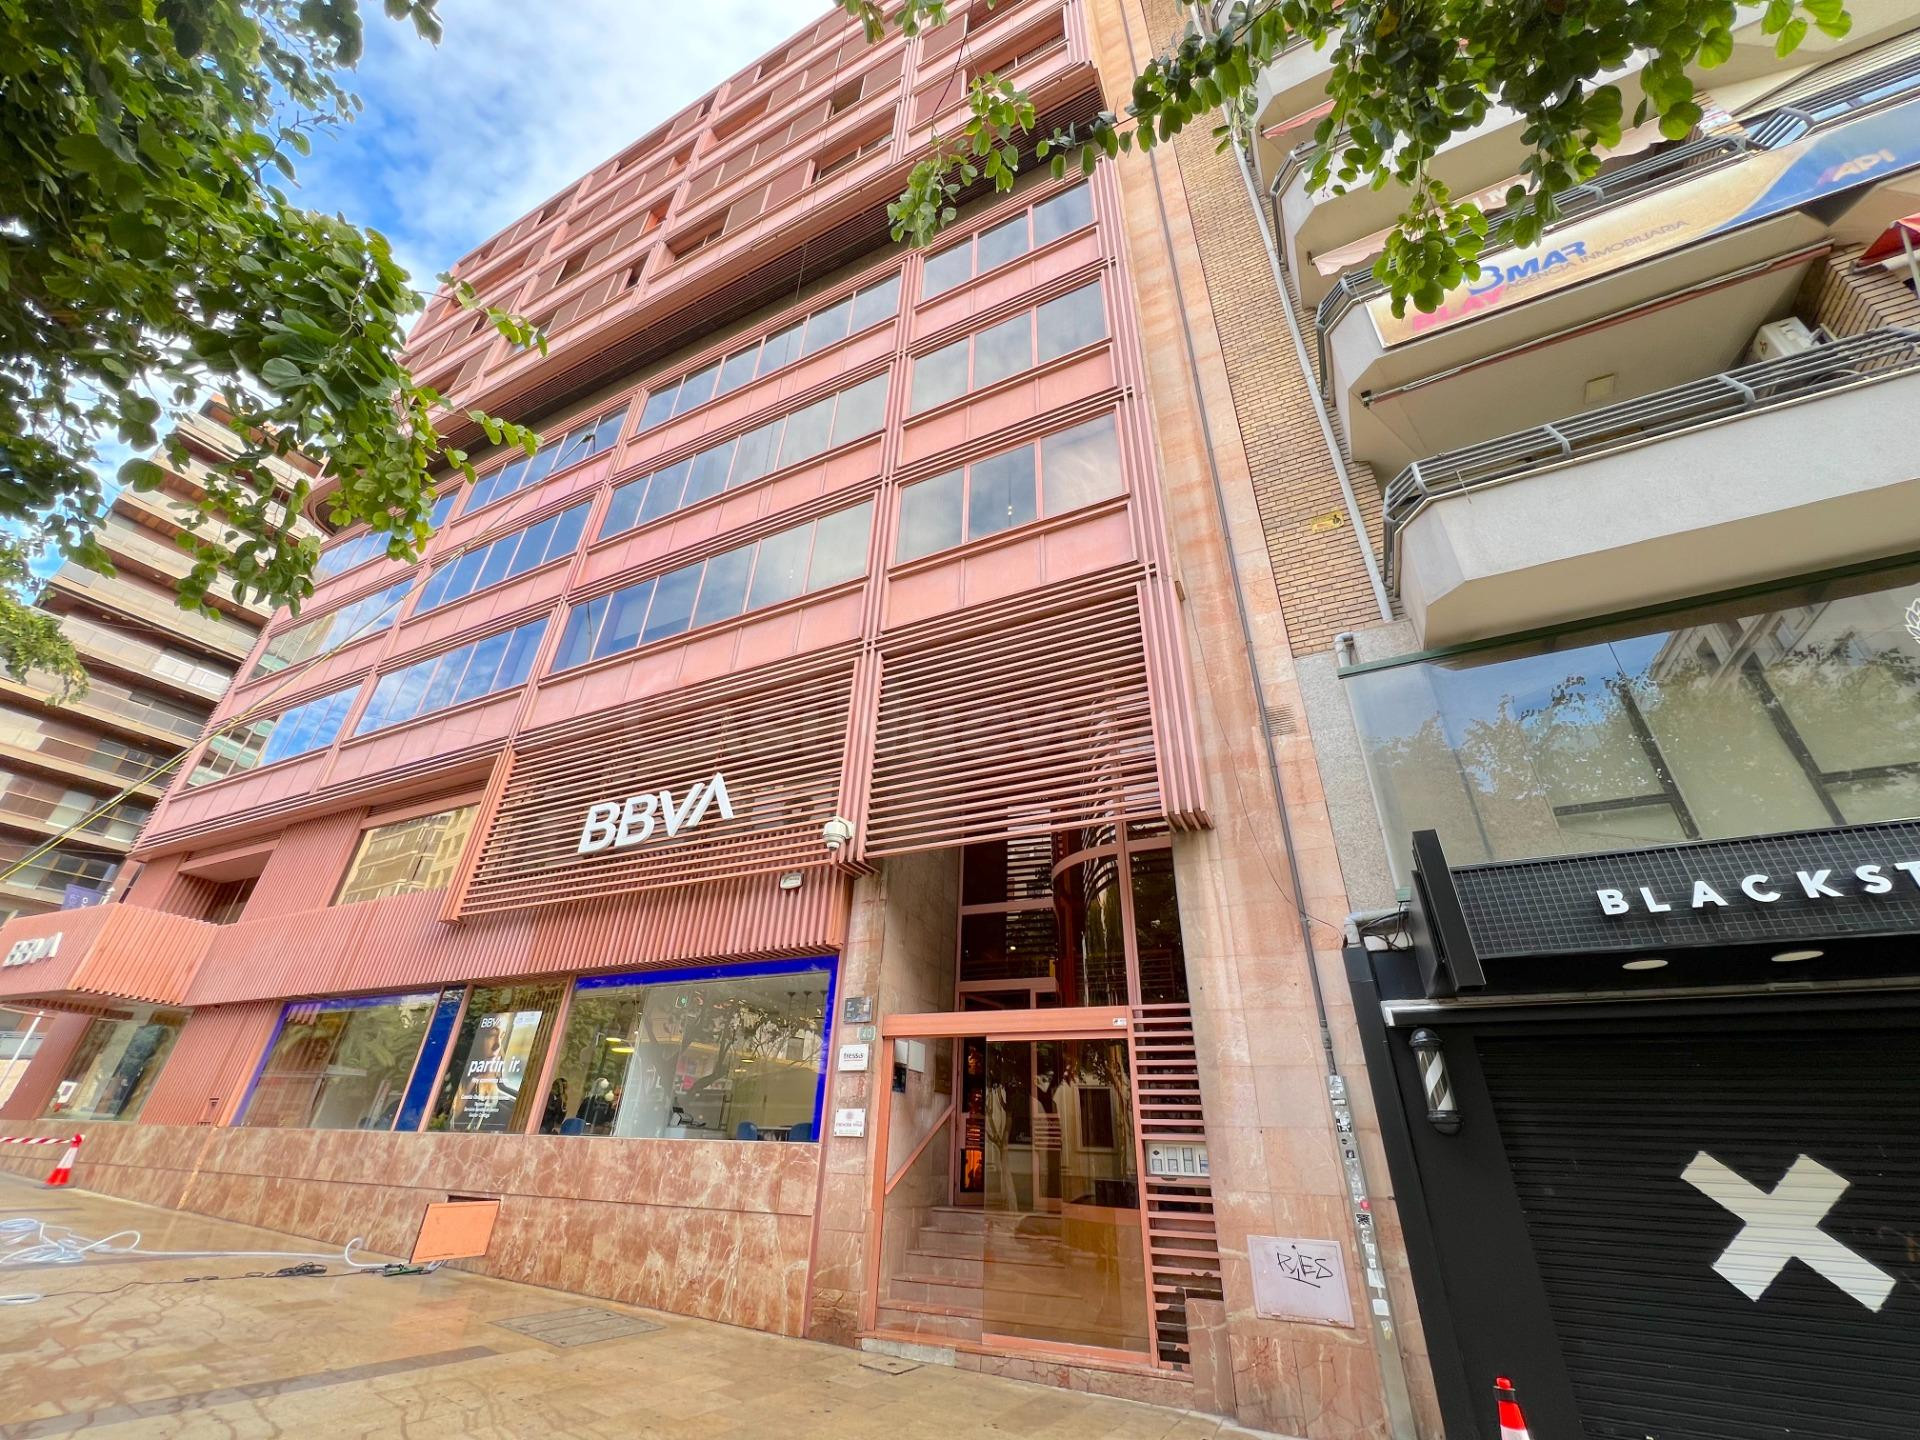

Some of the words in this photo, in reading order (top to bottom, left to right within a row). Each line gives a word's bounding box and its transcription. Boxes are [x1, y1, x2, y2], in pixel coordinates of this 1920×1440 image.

[1505, 261, 1577, 292] AGENCIA
[577, 771, 735, 855] BBVA
[2, 931, 63, 967] BBVA
